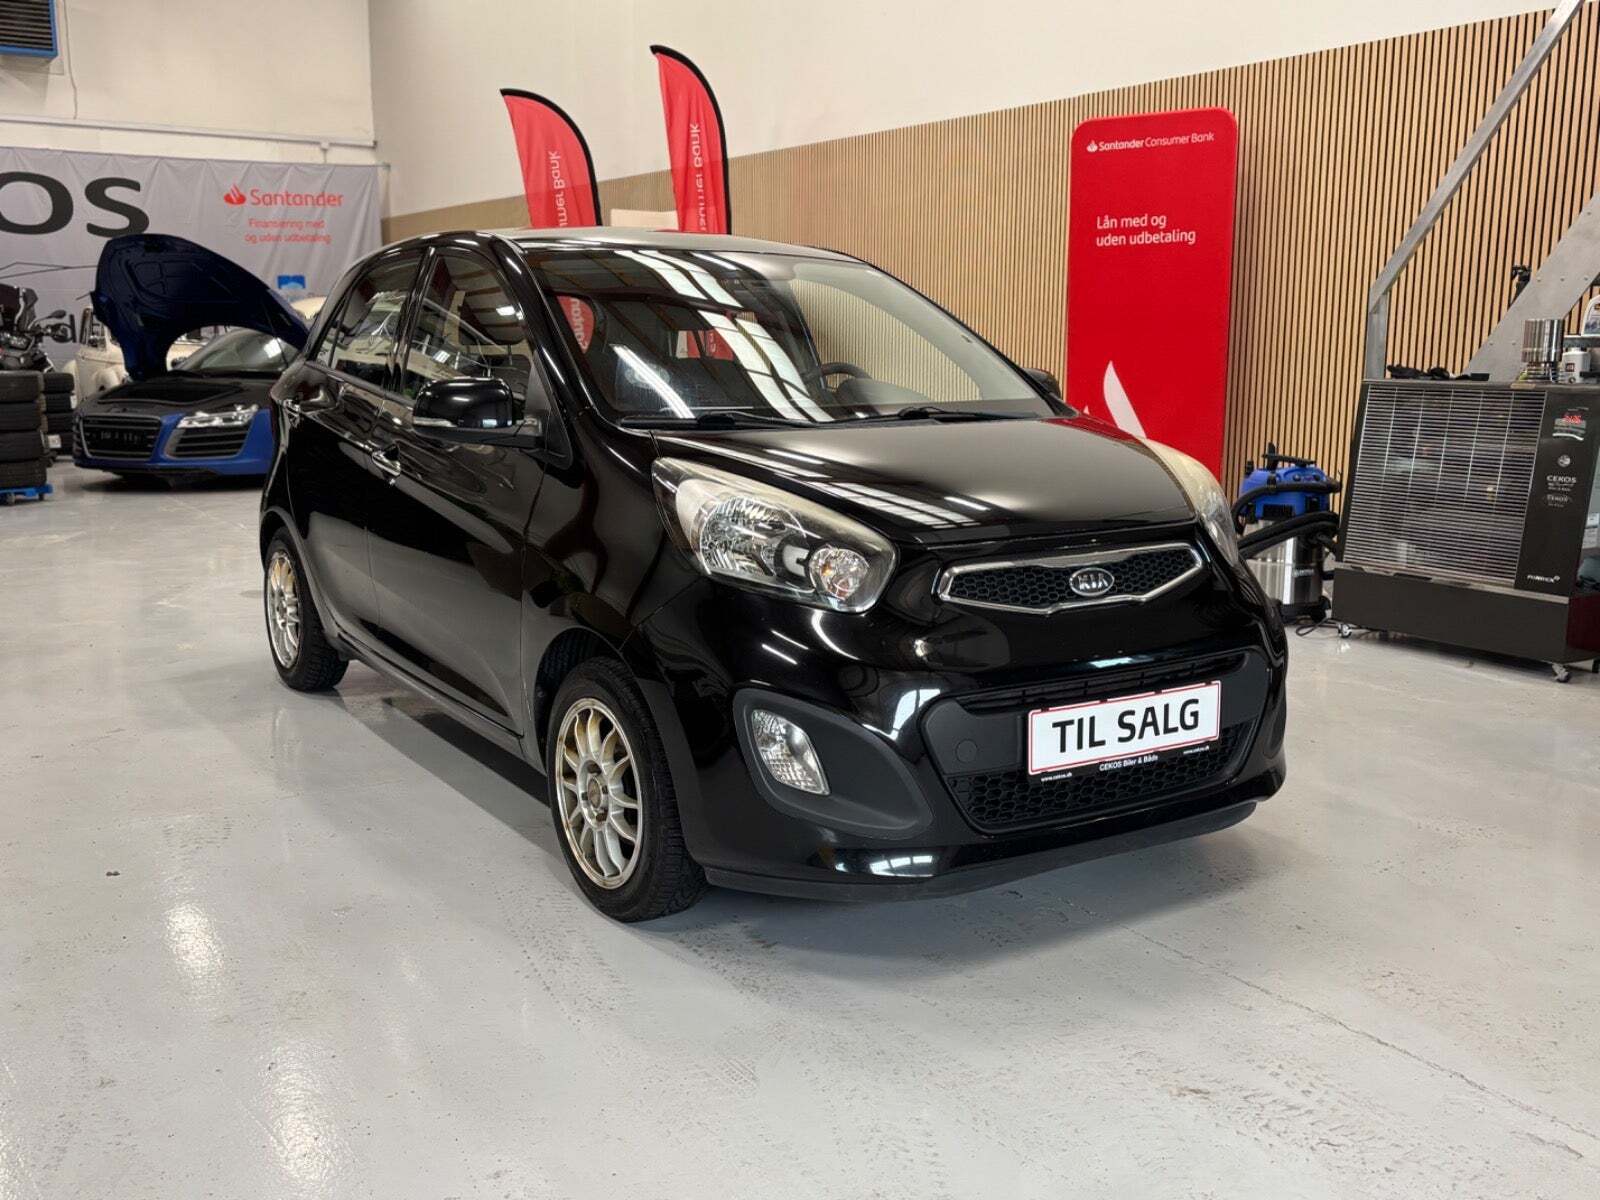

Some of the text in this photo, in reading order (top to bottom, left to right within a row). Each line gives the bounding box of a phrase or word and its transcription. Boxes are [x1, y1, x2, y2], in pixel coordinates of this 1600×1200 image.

[1098, 131, 1215, 152] Santander Consumer Bank
[249, 187, 344, 207] Santander
[1096, 213, 1167, 230] Lån med og
[1096, 228, 1197, 247] uden udbetaling
[1077, 573, 1108, 590] KIA
[1051, 698, 1200, 754] TIL SALG
